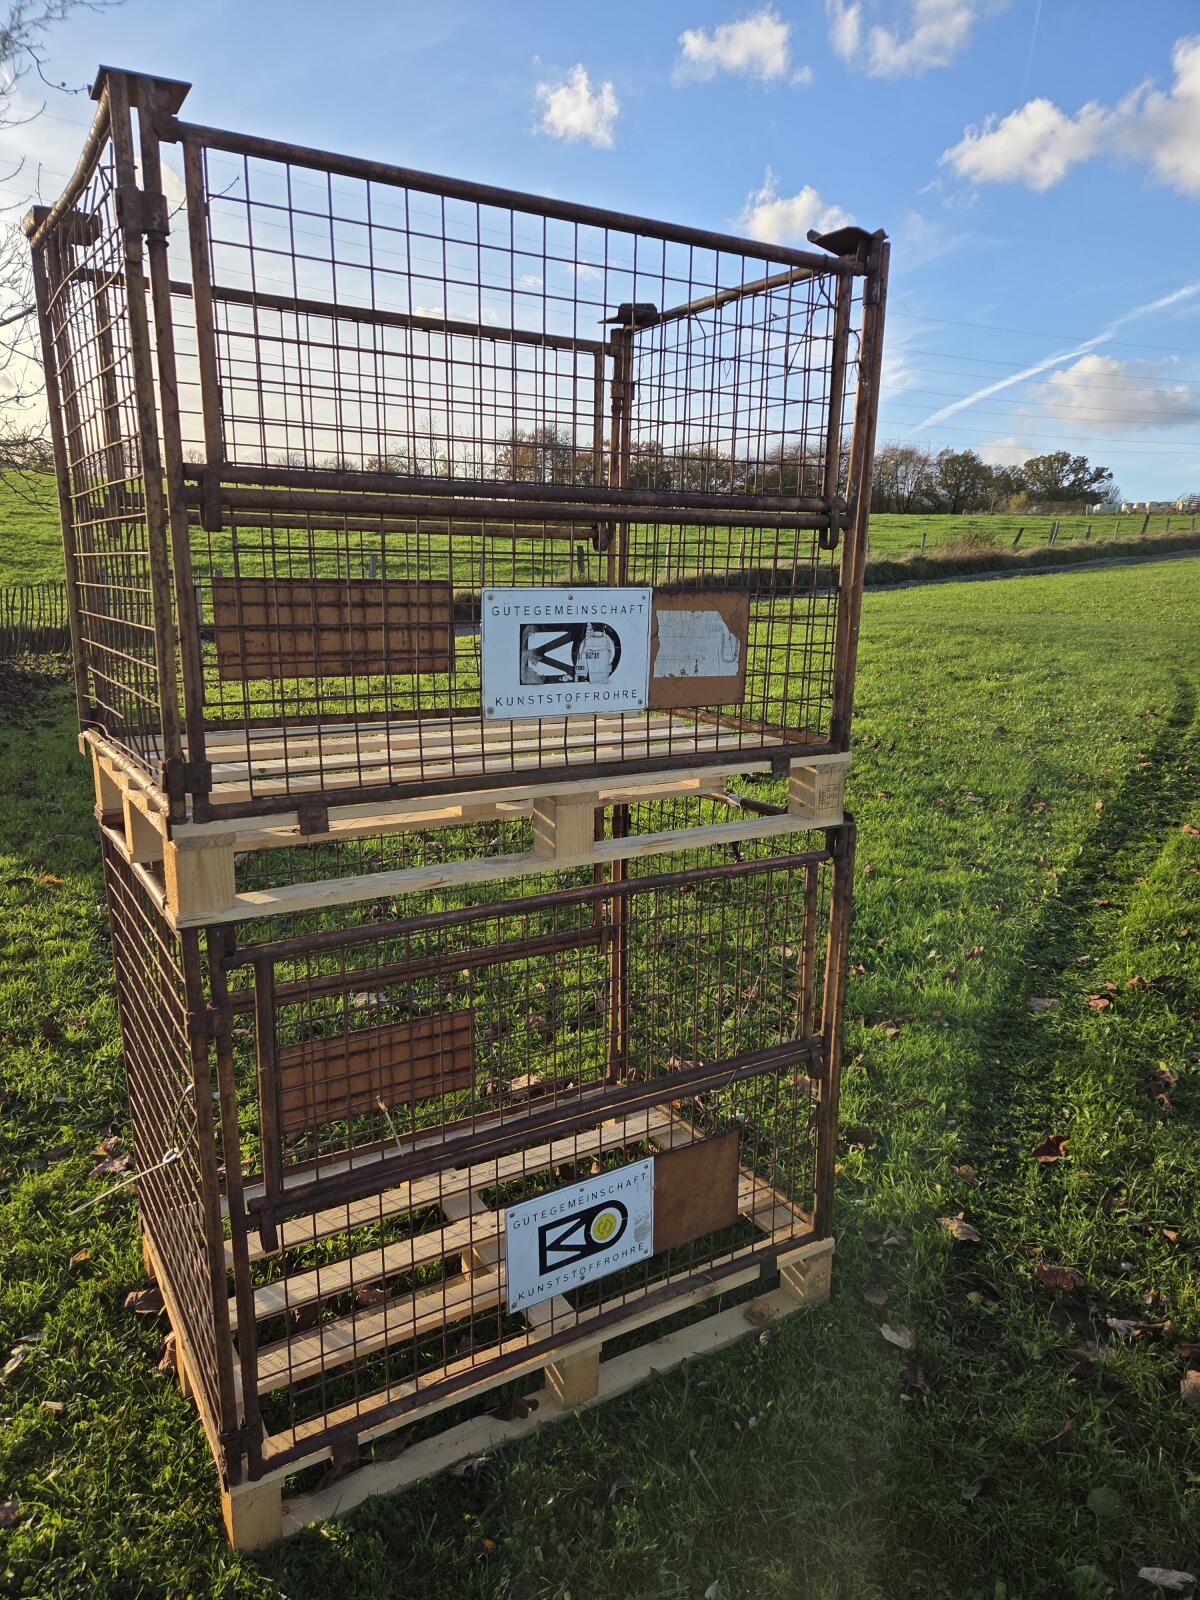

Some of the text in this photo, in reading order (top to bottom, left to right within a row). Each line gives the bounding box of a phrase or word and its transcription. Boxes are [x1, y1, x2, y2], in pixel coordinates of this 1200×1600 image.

[491, 602, 645, 617] GÜTEGEMEINSCHAFT
[495, 689, 638, 707] KUNSTSTOFFROHRE
[518, 1243, 645, 1299] KUNSTSTOFFROHRE
